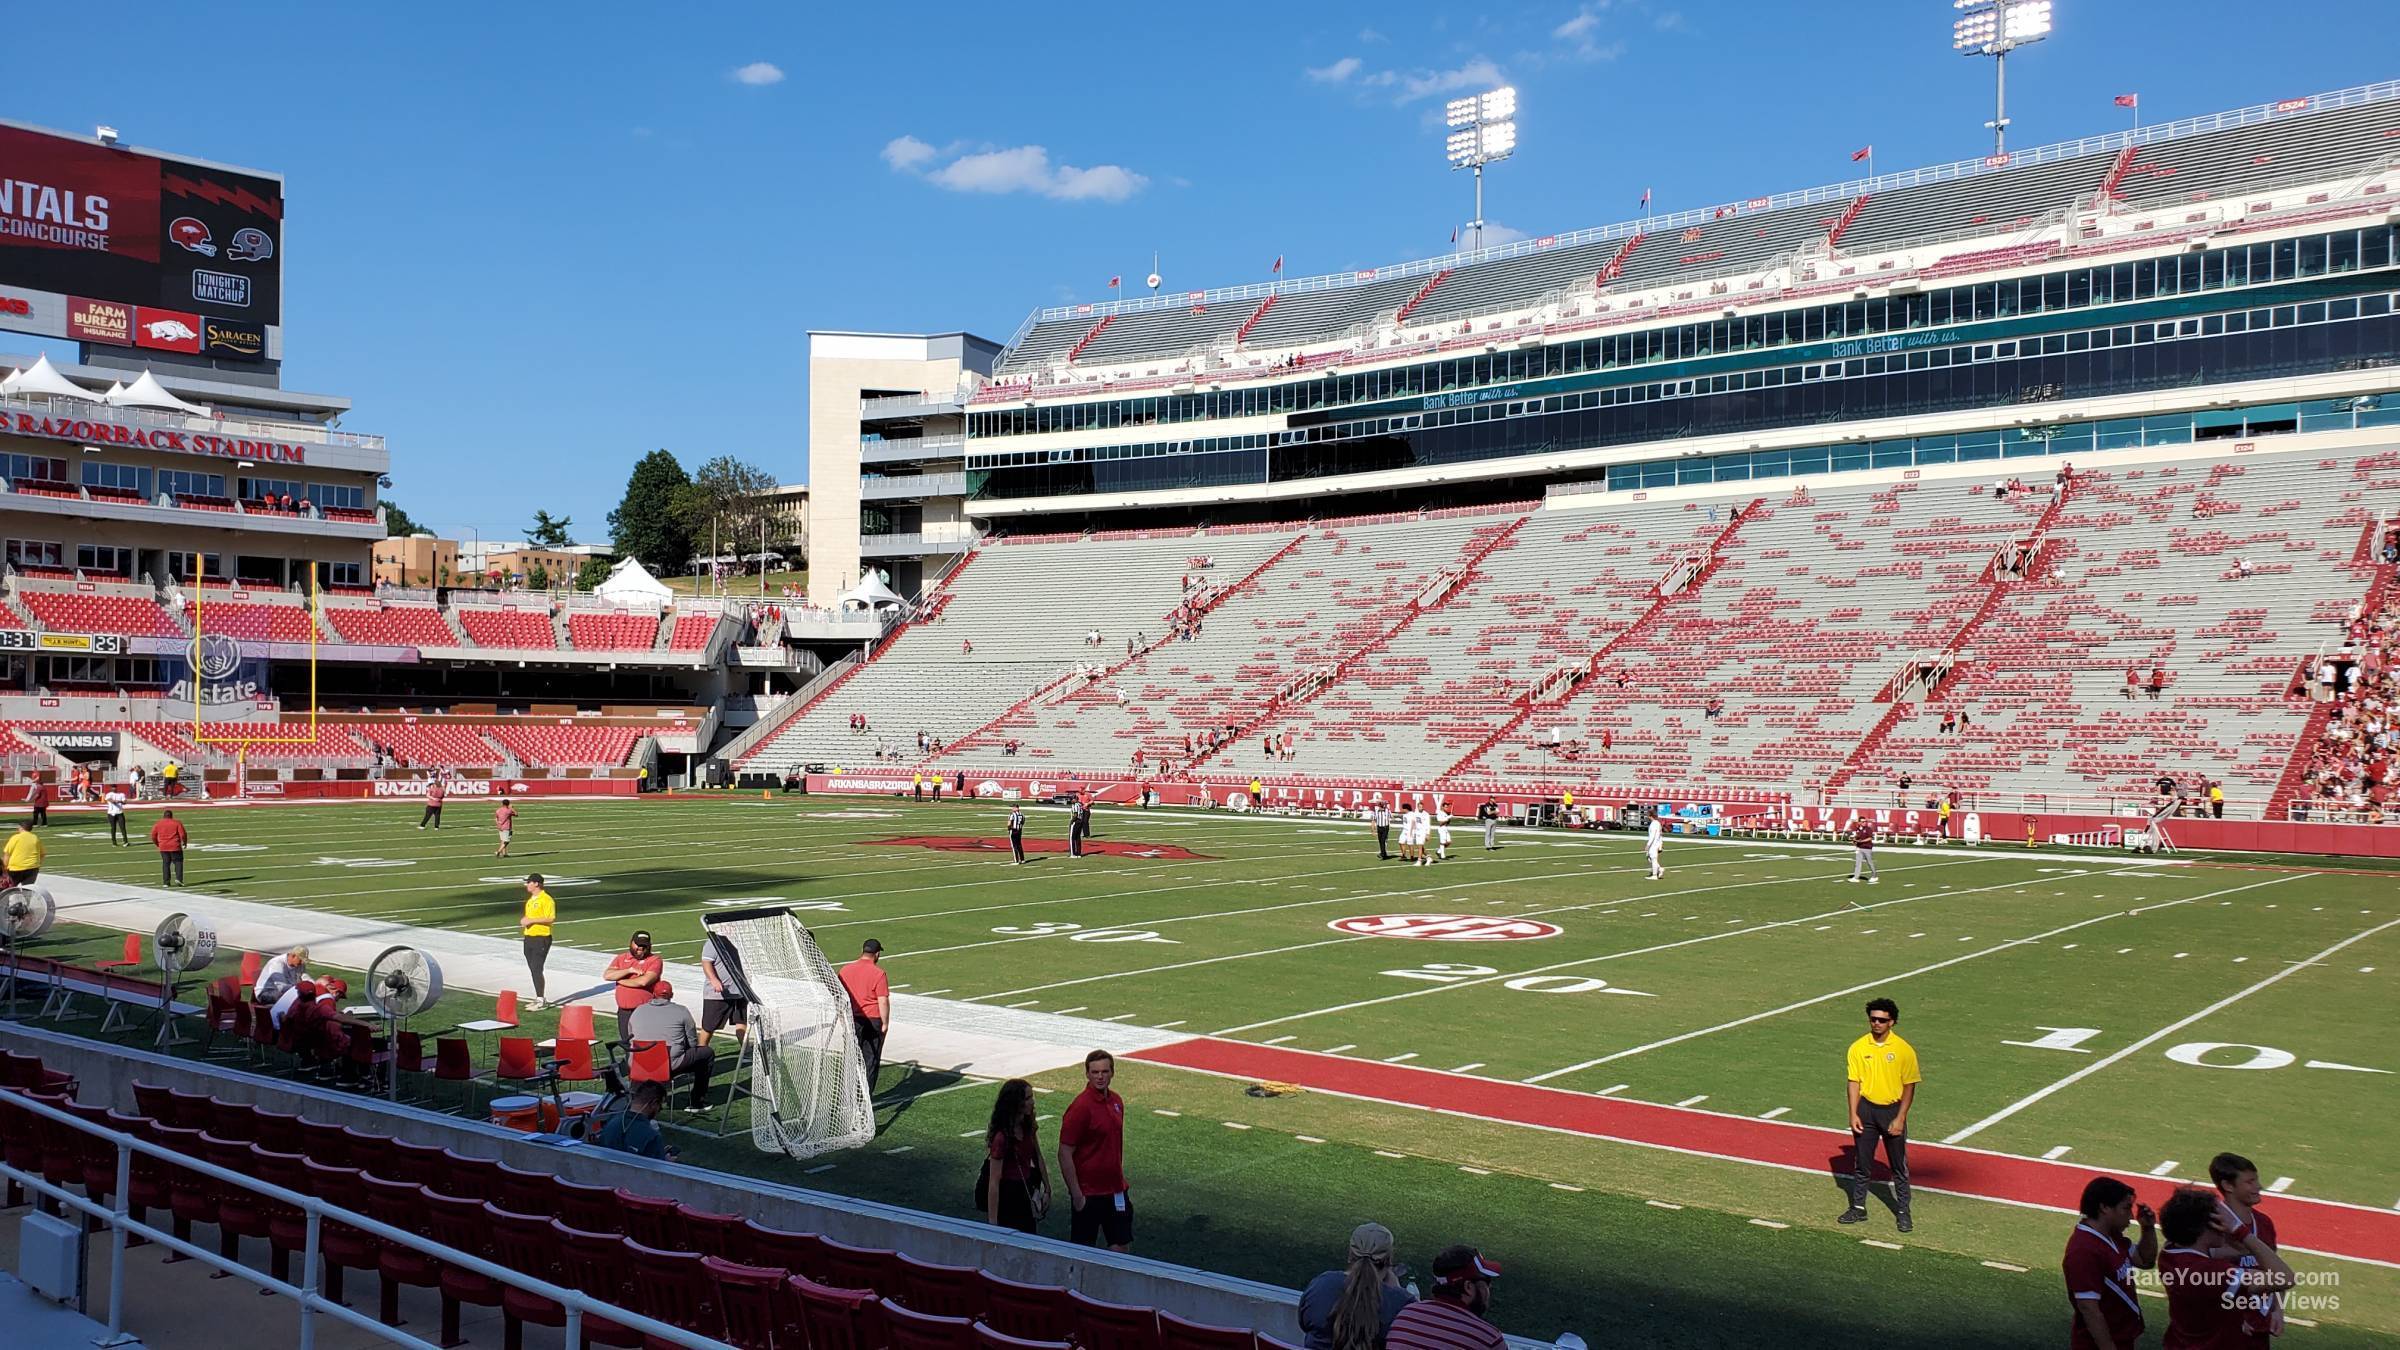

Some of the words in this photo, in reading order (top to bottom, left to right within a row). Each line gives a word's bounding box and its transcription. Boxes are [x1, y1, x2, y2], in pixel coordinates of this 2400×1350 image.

[2278, 100, 2305, 112] E524
[1986, 156, 2009, 167] E523
[1748, 199, 1767, 209] E522
[0, 216, 109, 252] CONCOURSE
[197, 273, 245, 290] TONIGHT'S
[197, 284, 244, 302] MATCHUP
[89, 303, 126, 319] FARM
[74, 312, 127, 329] BUREAU
[83, 327, 127, 339] INSURANCE
[207, 324, 261, 342] SARACEN
[1832, 342, 1862, 358] Bank
[1866, 336, 1905, 353] Better
[1908, 331, 1938, 346] with
[1423, 394, 1446, 410] Bank
[1448, 391, 1478, 407] Better
[1480, 387, 1503, 400] with
[15, 412, 186, 450] RAZORBACK
[192, 434, 305, 463] STADIUM
[96, 636, 116, 651] 25
[374, 781, 490, 795] RAZOACKS
[827, 779, 953, 791] ARKANSASRAZORBAKS.OM
[198, 931, 216, 940] BIG
[991, 923, 1160, 943] 30
[1347, 914, 1543, 940] SEC
[1378, 964, 1607, 993] 20
[2001, 1027, 2297, 1070] 10
